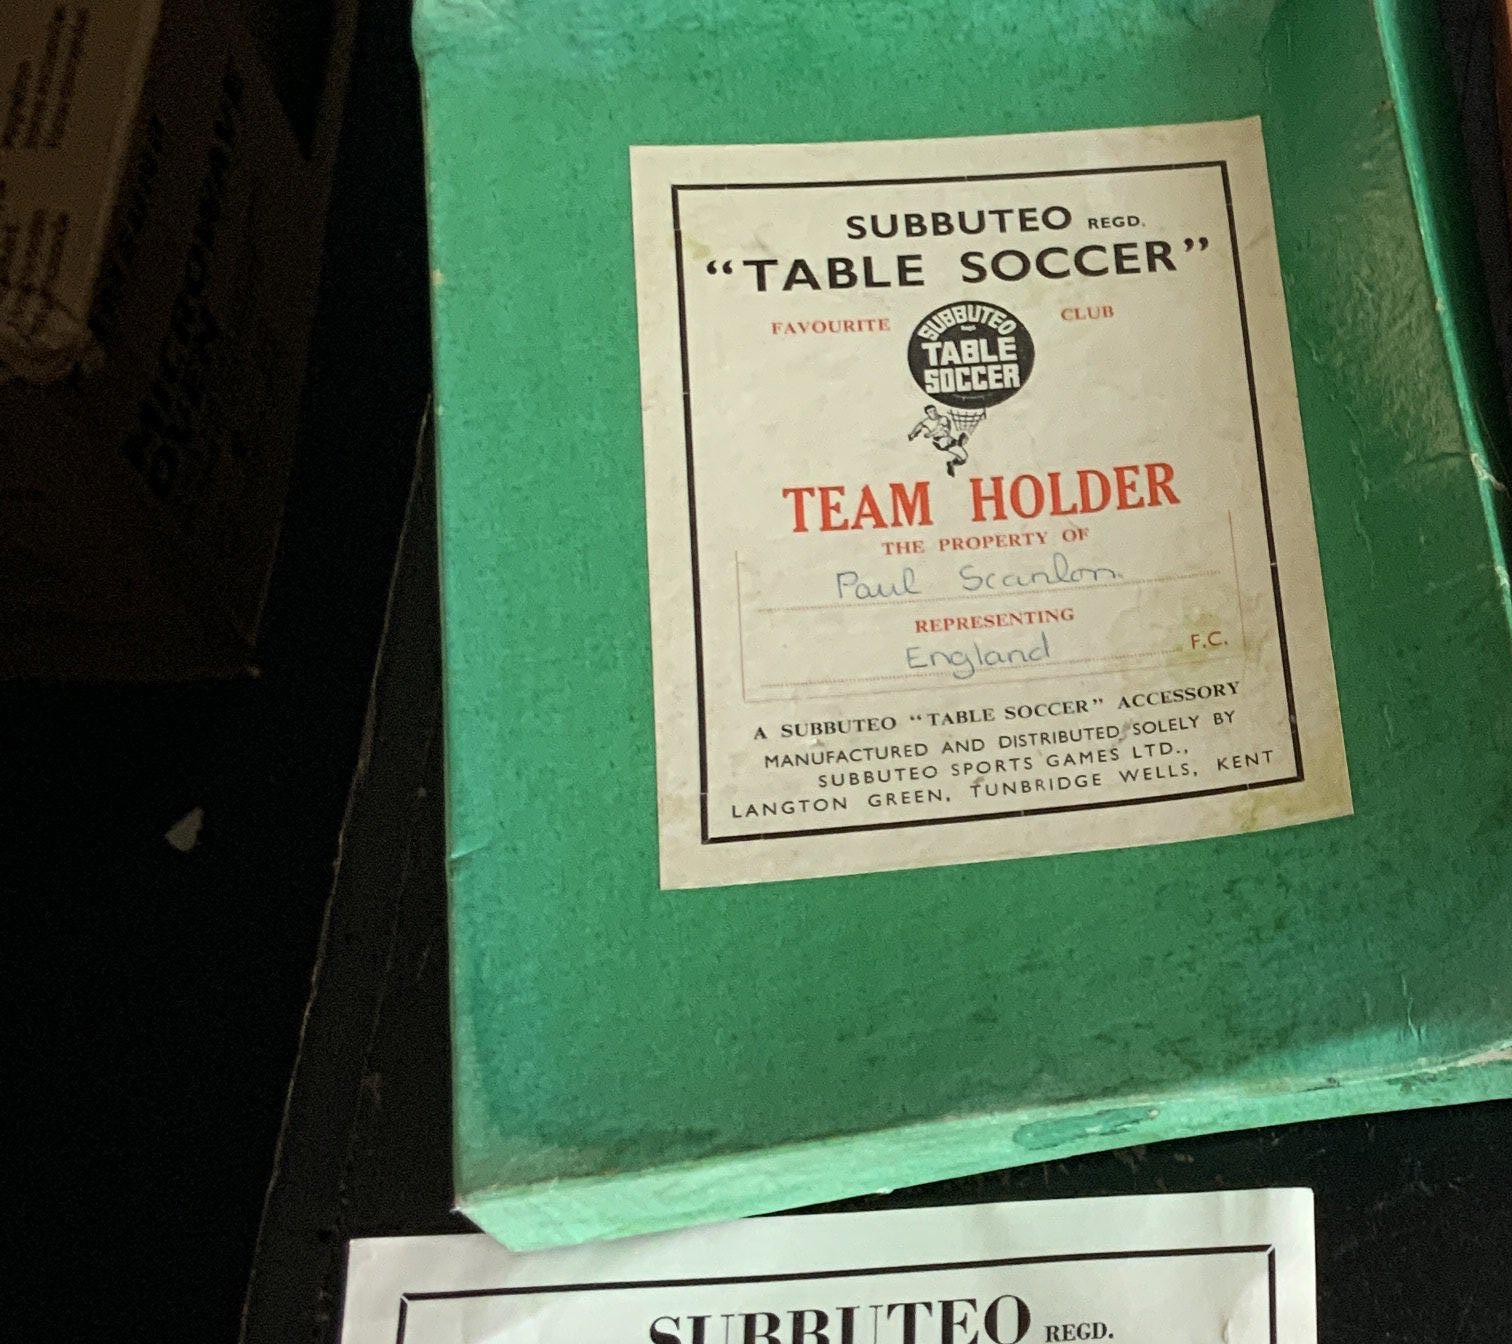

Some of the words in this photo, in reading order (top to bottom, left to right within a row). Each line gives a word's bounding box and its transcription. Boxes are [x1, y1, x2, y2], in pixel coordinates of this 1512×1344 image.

[846, 206, 1072, 240] SUBBUTEO
[1088, 216, 1145, 229] REGD.
[706, 254, 924, 292] “TABLE
[960, 237, 1208, 283] SOCCER”
[771, 318, 890, 335] FAVOURITE
[917, 304, 1017, 342] SUBBUTEO
[1061, 304, 1114, 322] CLUB
[921, 336, 1018, 367] TABLE
[924, 363, 1020, 394] SOCCER
[781, 481, 932, 534] TEAM
[971, 463, 1181, 524] HOLDER
[881, 541, 925, 555] THE
[939, 532, 1047, 551] PROPERTY
[1062, 527, 1089, 542] OF
[835, 567, 923, 600] Paul
[914, 608, 1075, 633] REPRESENTING
[906, 632, 1051, 680] England
[754, 727, 768, 740] A
[781, 717, 897, 738] SUBBUTEO
[910, 708, 995, 726] “TABLE
[1005, 698, 1103, 720] SOCCER”
[1118, 681, 1239, 709] ACCESSORY
[764, 742, 929, 769] MANUFACTURED
[941, 738, 986, 755] AND
[998, 724, 1119, 750] DISTRIBUTED
[1132, 715, 1200, 737] SOLELY
[1213, 710, 1237, 726] BY
[818, 766, 937, 788] SUBBUTEO
[951, 757, 1032, 776] SPORTS
[1046, 744, 1119, 767] GAMES
[1133, 742, 1188, 759] LTD.,
[732, 797, 847, 818] LANGTON
[868, 789, 950, 807] GREEN,
[970, 773, 1101, 797] TUNBRIDGE
[1119, 763, 1197, 783] WELLS,
[1217, 750, 1273, 771] KENT
[1045, 1322, 1113, 1343] REGD.
